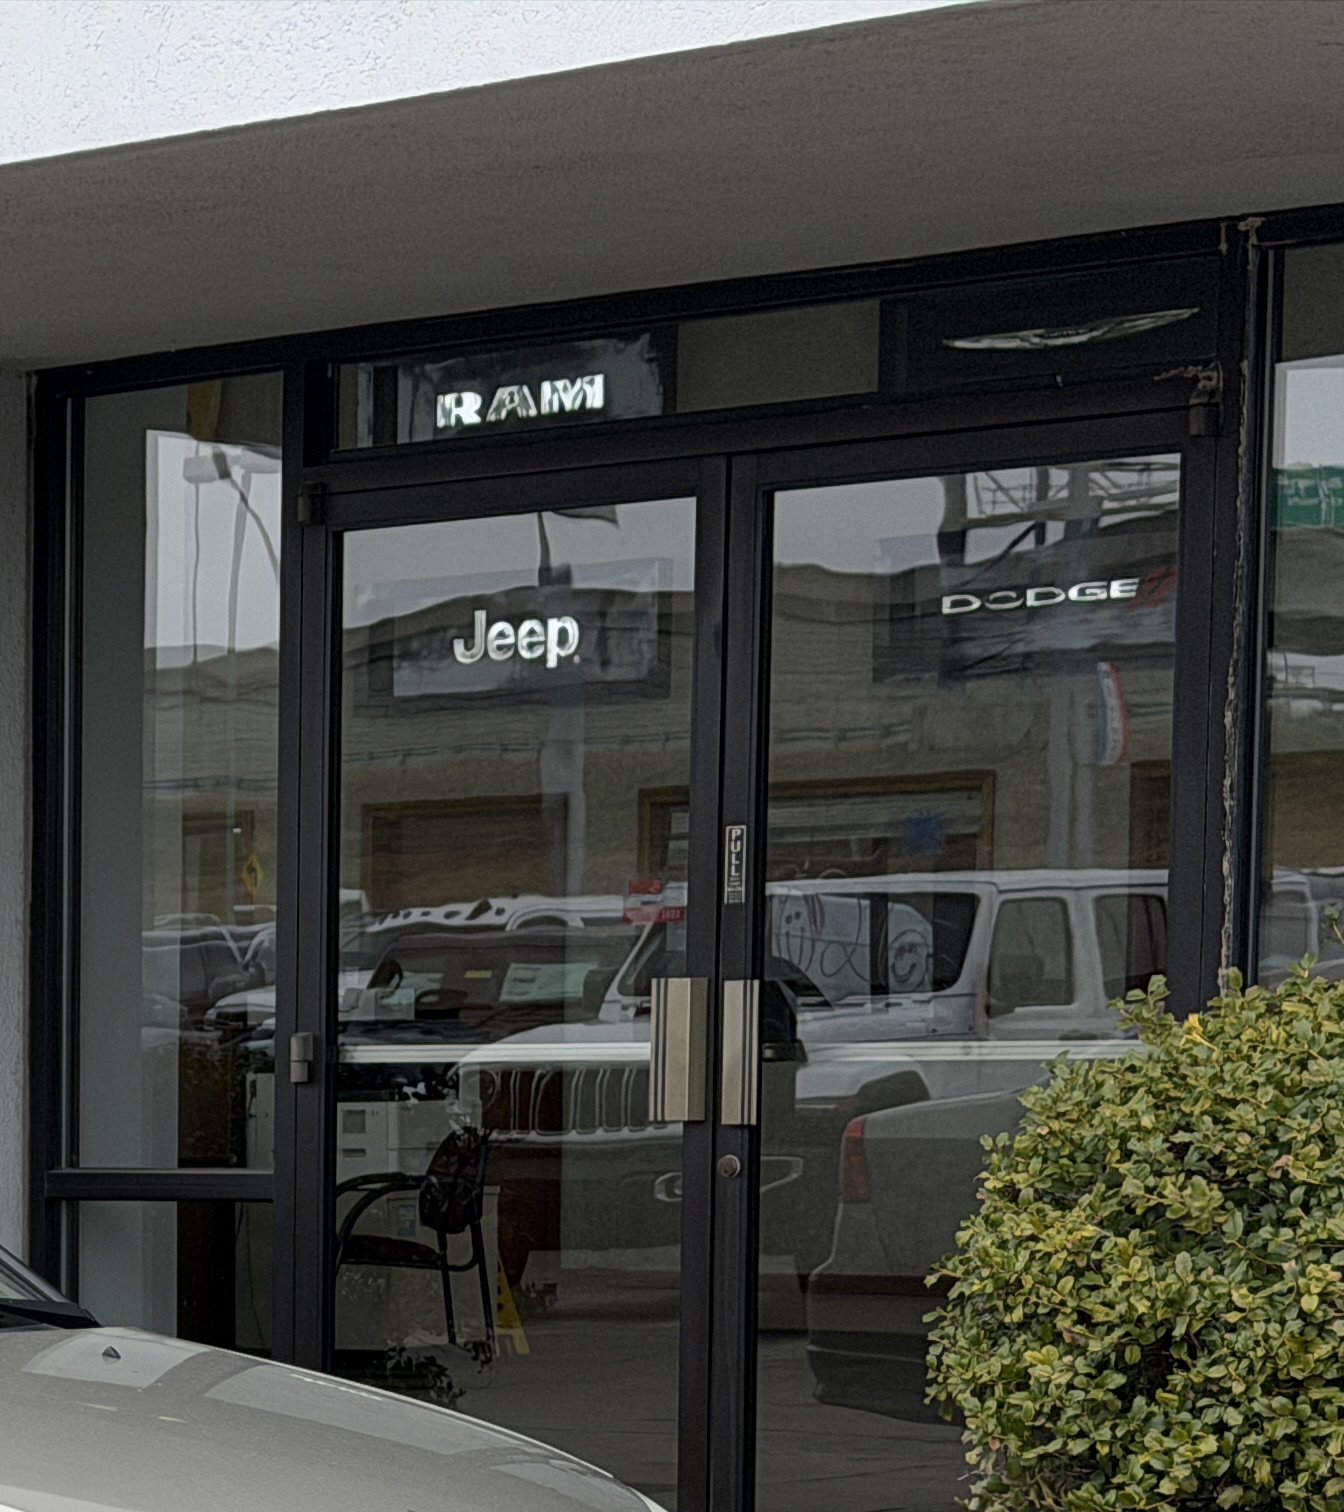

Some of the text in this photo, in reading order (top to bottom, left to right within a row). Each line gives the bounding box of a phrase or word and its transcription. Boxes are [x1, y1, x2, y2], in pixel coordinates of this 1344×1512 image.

[436, 374, 605, 428] RAM
[942, 577, 1140, 615] DODGE
[453, 609, 580, 668] Jeep
[730, 828, 742, 876] PULL
